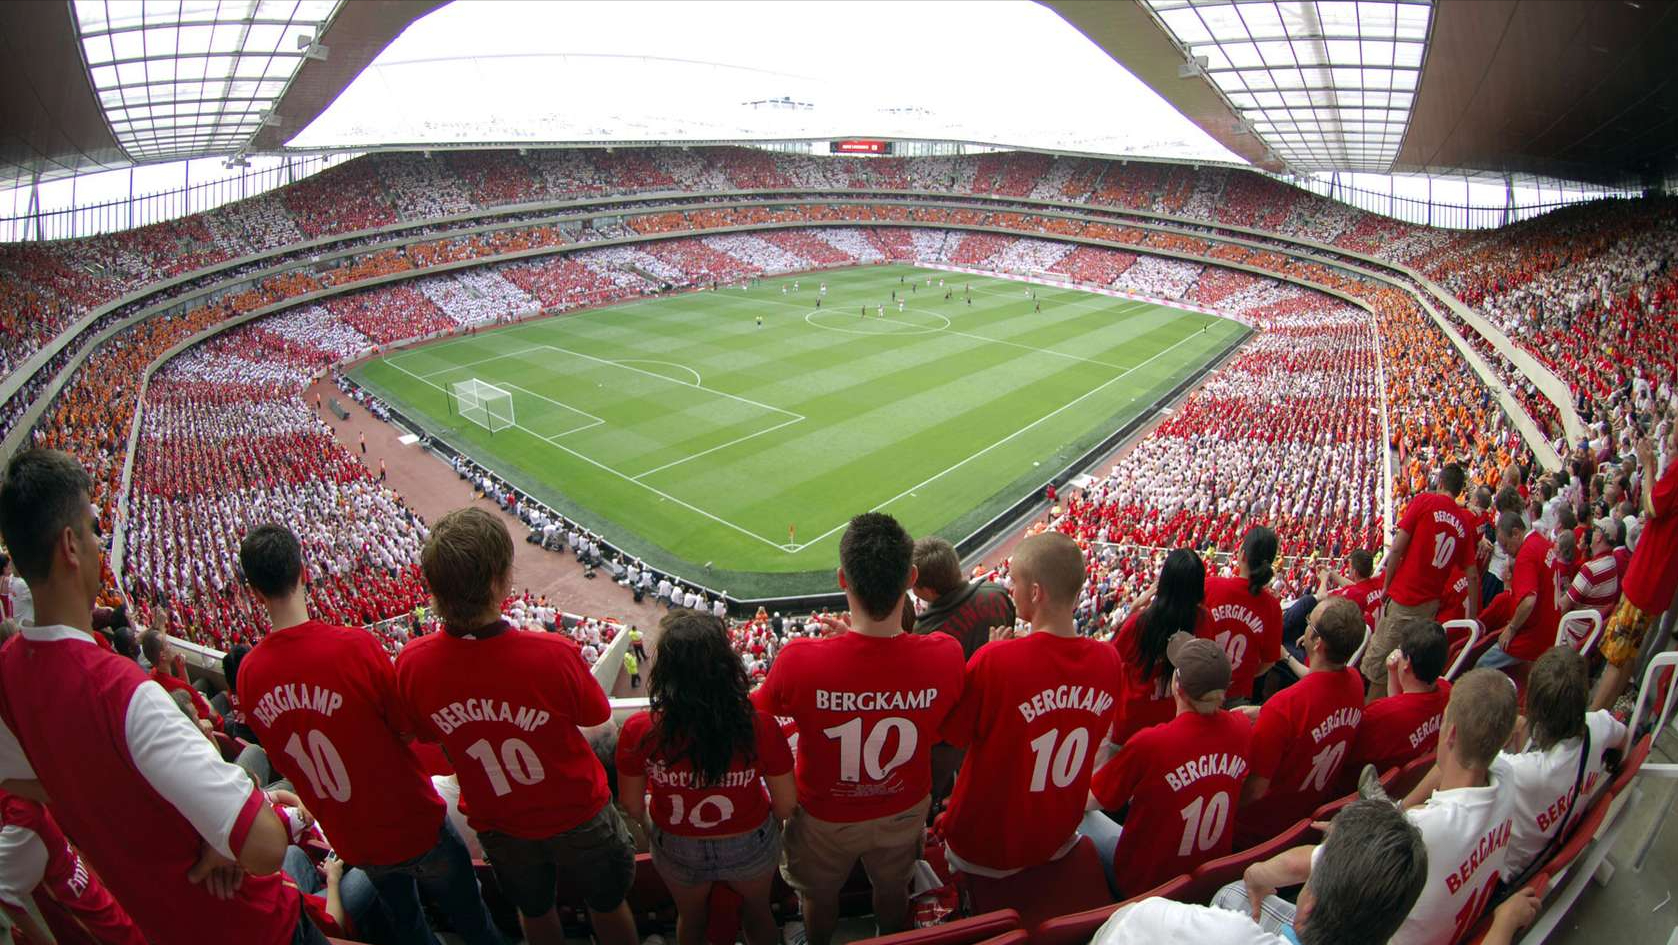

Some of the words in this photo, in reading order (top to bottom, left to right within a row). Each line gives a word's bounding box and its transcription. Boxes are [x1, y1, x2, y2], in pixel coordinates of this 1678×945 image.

[1432, 532, 1456, 569] 10
[1215, 630, 1247, 670] 10
[253, 683, 343, 728] BERGKAMP
[430, 698, 550, 735] BERGKAMP
[816, 688, 938, 711] BERGKAMP
[1018, 685, 1114, 723] BERGKAMP
[284, 729, 351, 802] 10
[465, 738, 545, 797] 10
[823, 716, 918, 782] 10
[1030, 726, 1089, 792] 10
[1298, 740, 1347, 792] 10
[645, 759, 756, 790] Bergmp
[1164, 752, 1247, 792] BERGKAMP
[667, 794, 734, 829] 10
[1178, 791, 1230, 856] 10
